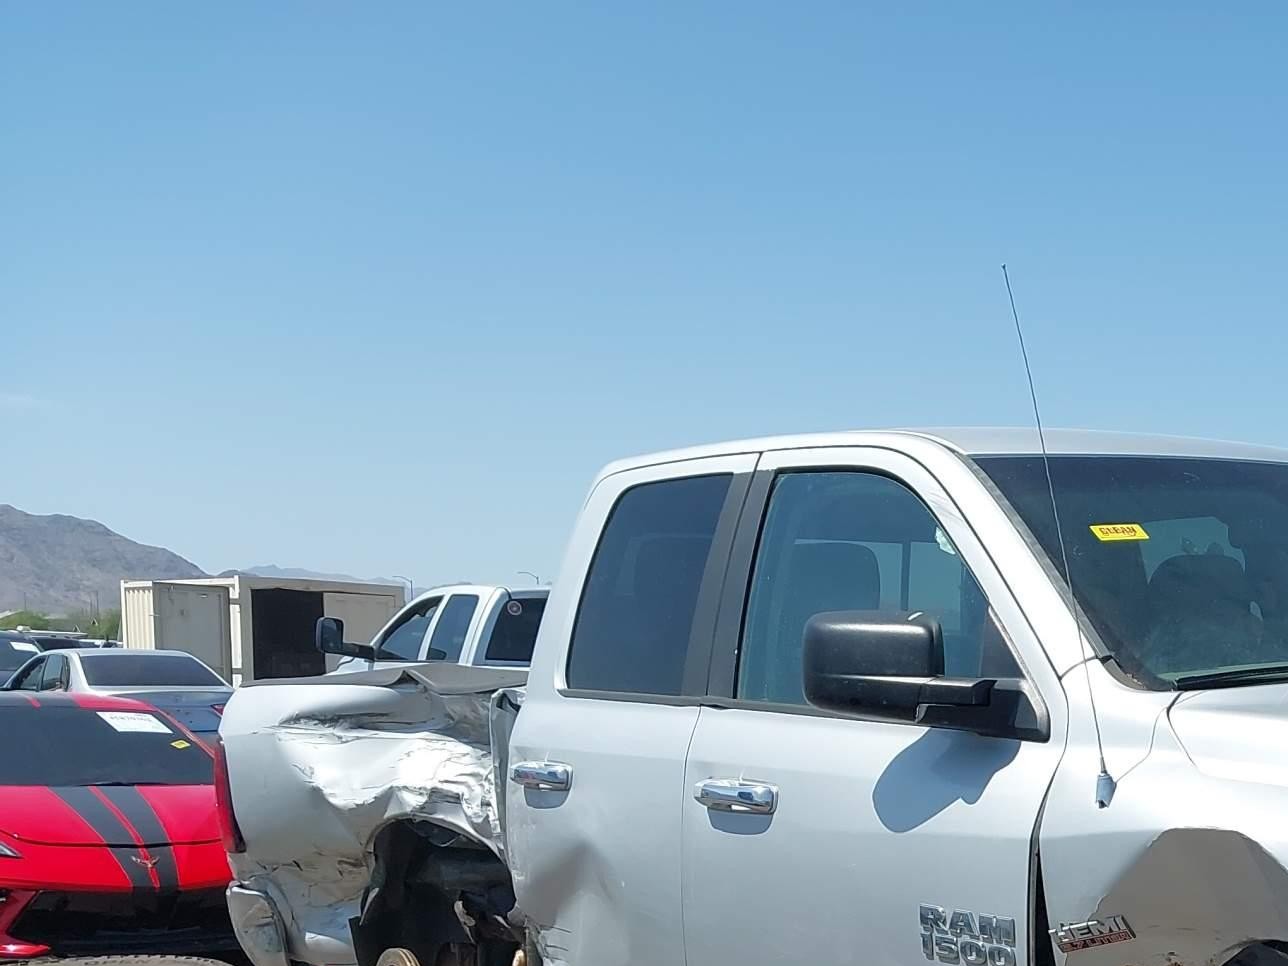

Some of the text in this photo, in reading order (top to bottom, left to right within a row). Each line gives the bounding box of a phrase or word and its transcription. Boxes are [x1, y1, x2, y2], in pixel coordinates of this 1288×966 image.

[919, 903, 1017, 948] RAM
[1048, 915, 1135, 945] HEMI
[1086, 930, 1132, 947] LITER
